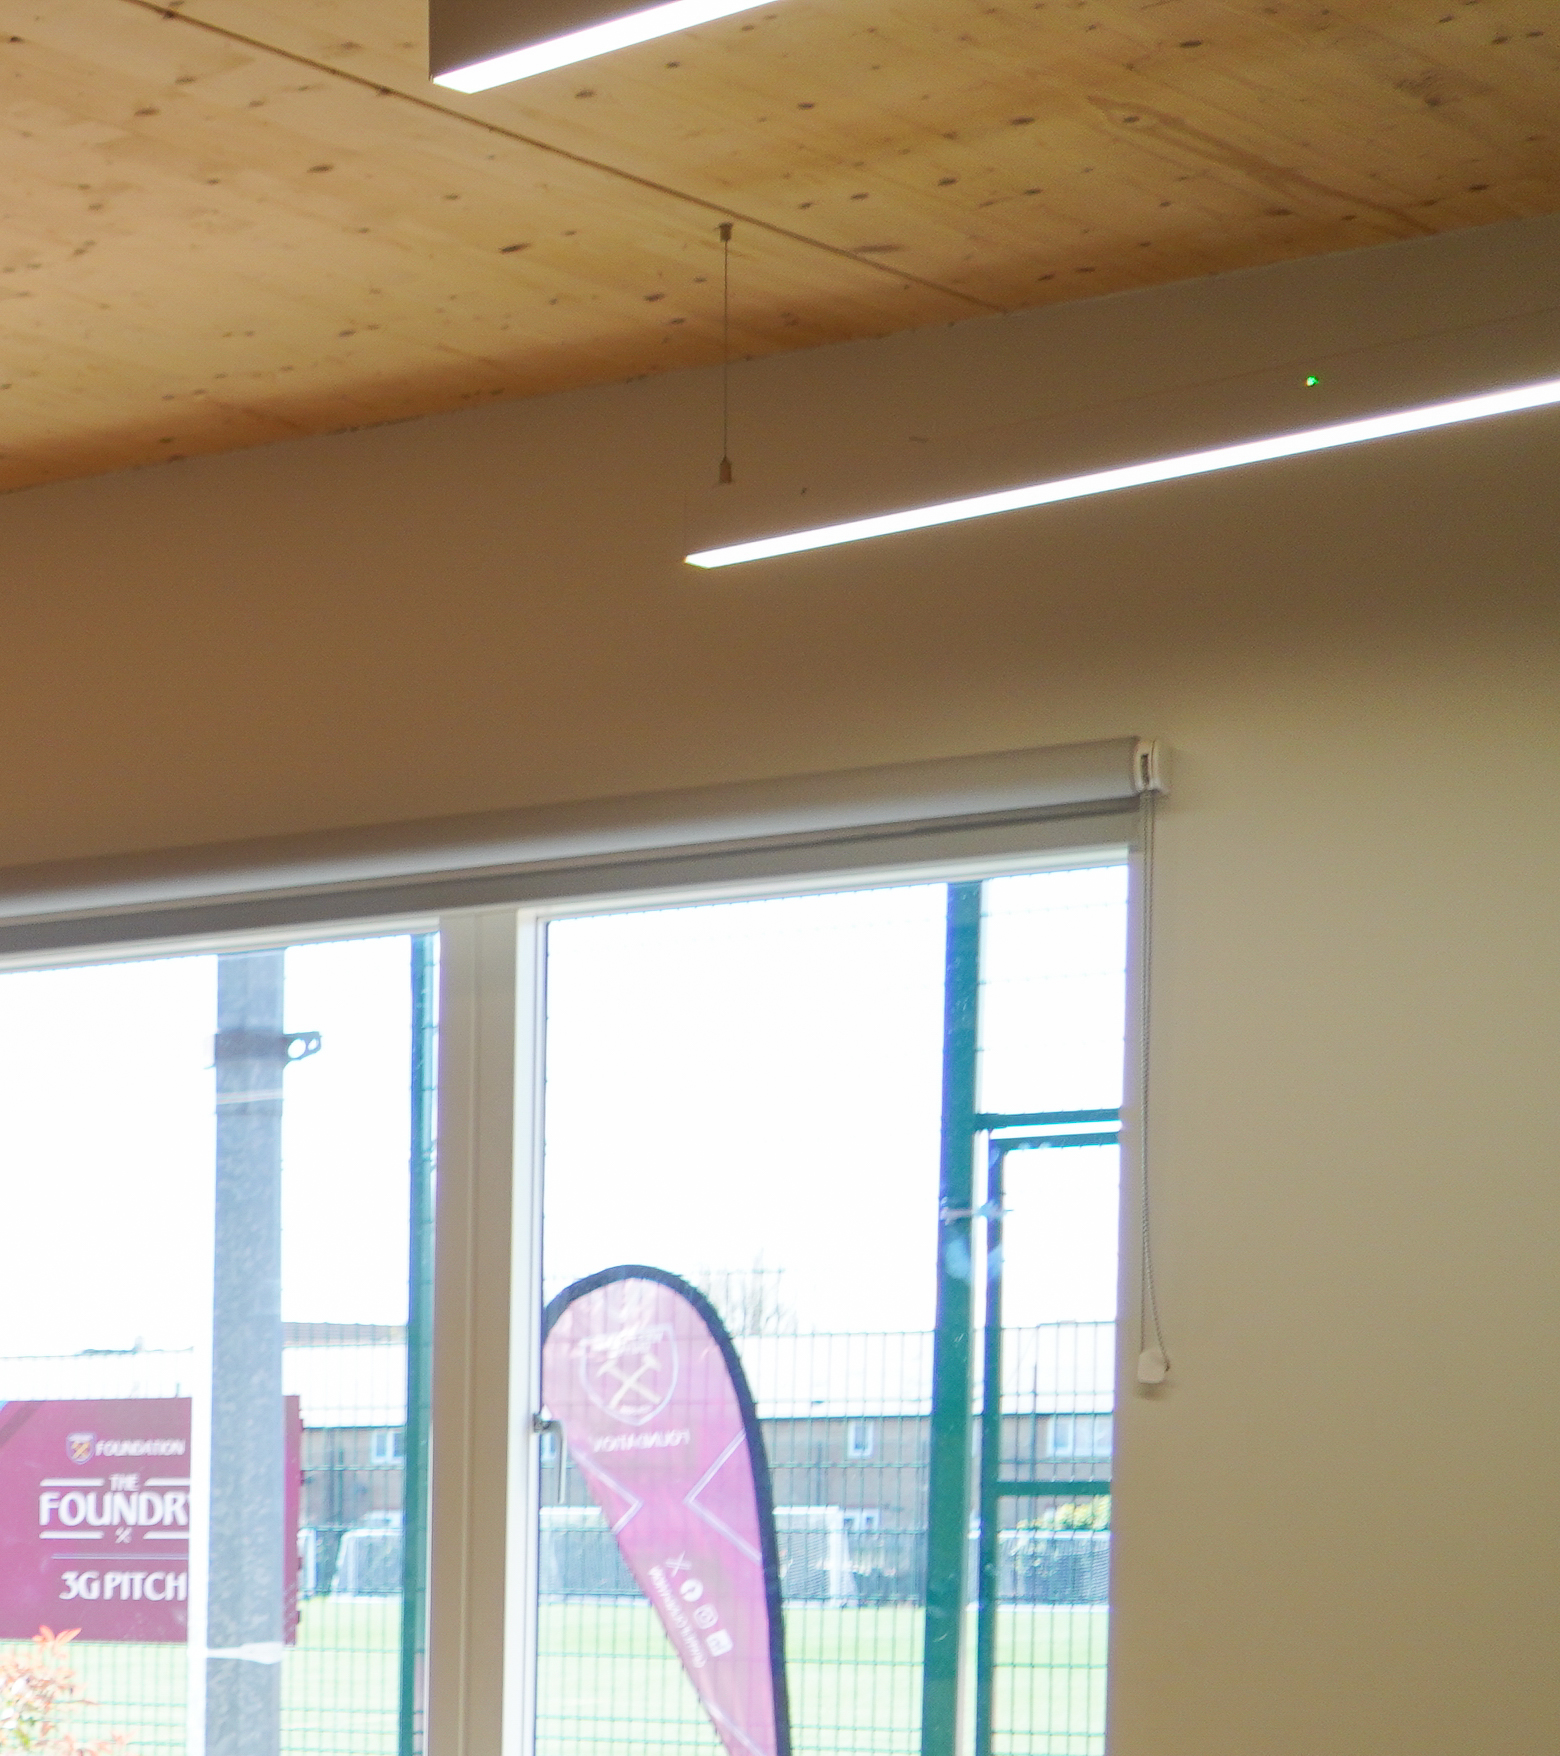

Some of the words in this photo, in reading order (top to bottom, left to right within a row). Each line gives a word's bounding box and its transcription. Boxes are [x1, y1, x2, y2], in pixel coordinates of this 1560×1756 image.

[95, 1439, 187, 1457] FOUNDATION
[109, 1473, 140, 1492] THE
[38, 1491, 191, 1526] FOUNDR
[58, 1570, 102, 1601] 3G
[102, 1571, 189, 1602] PITCH
